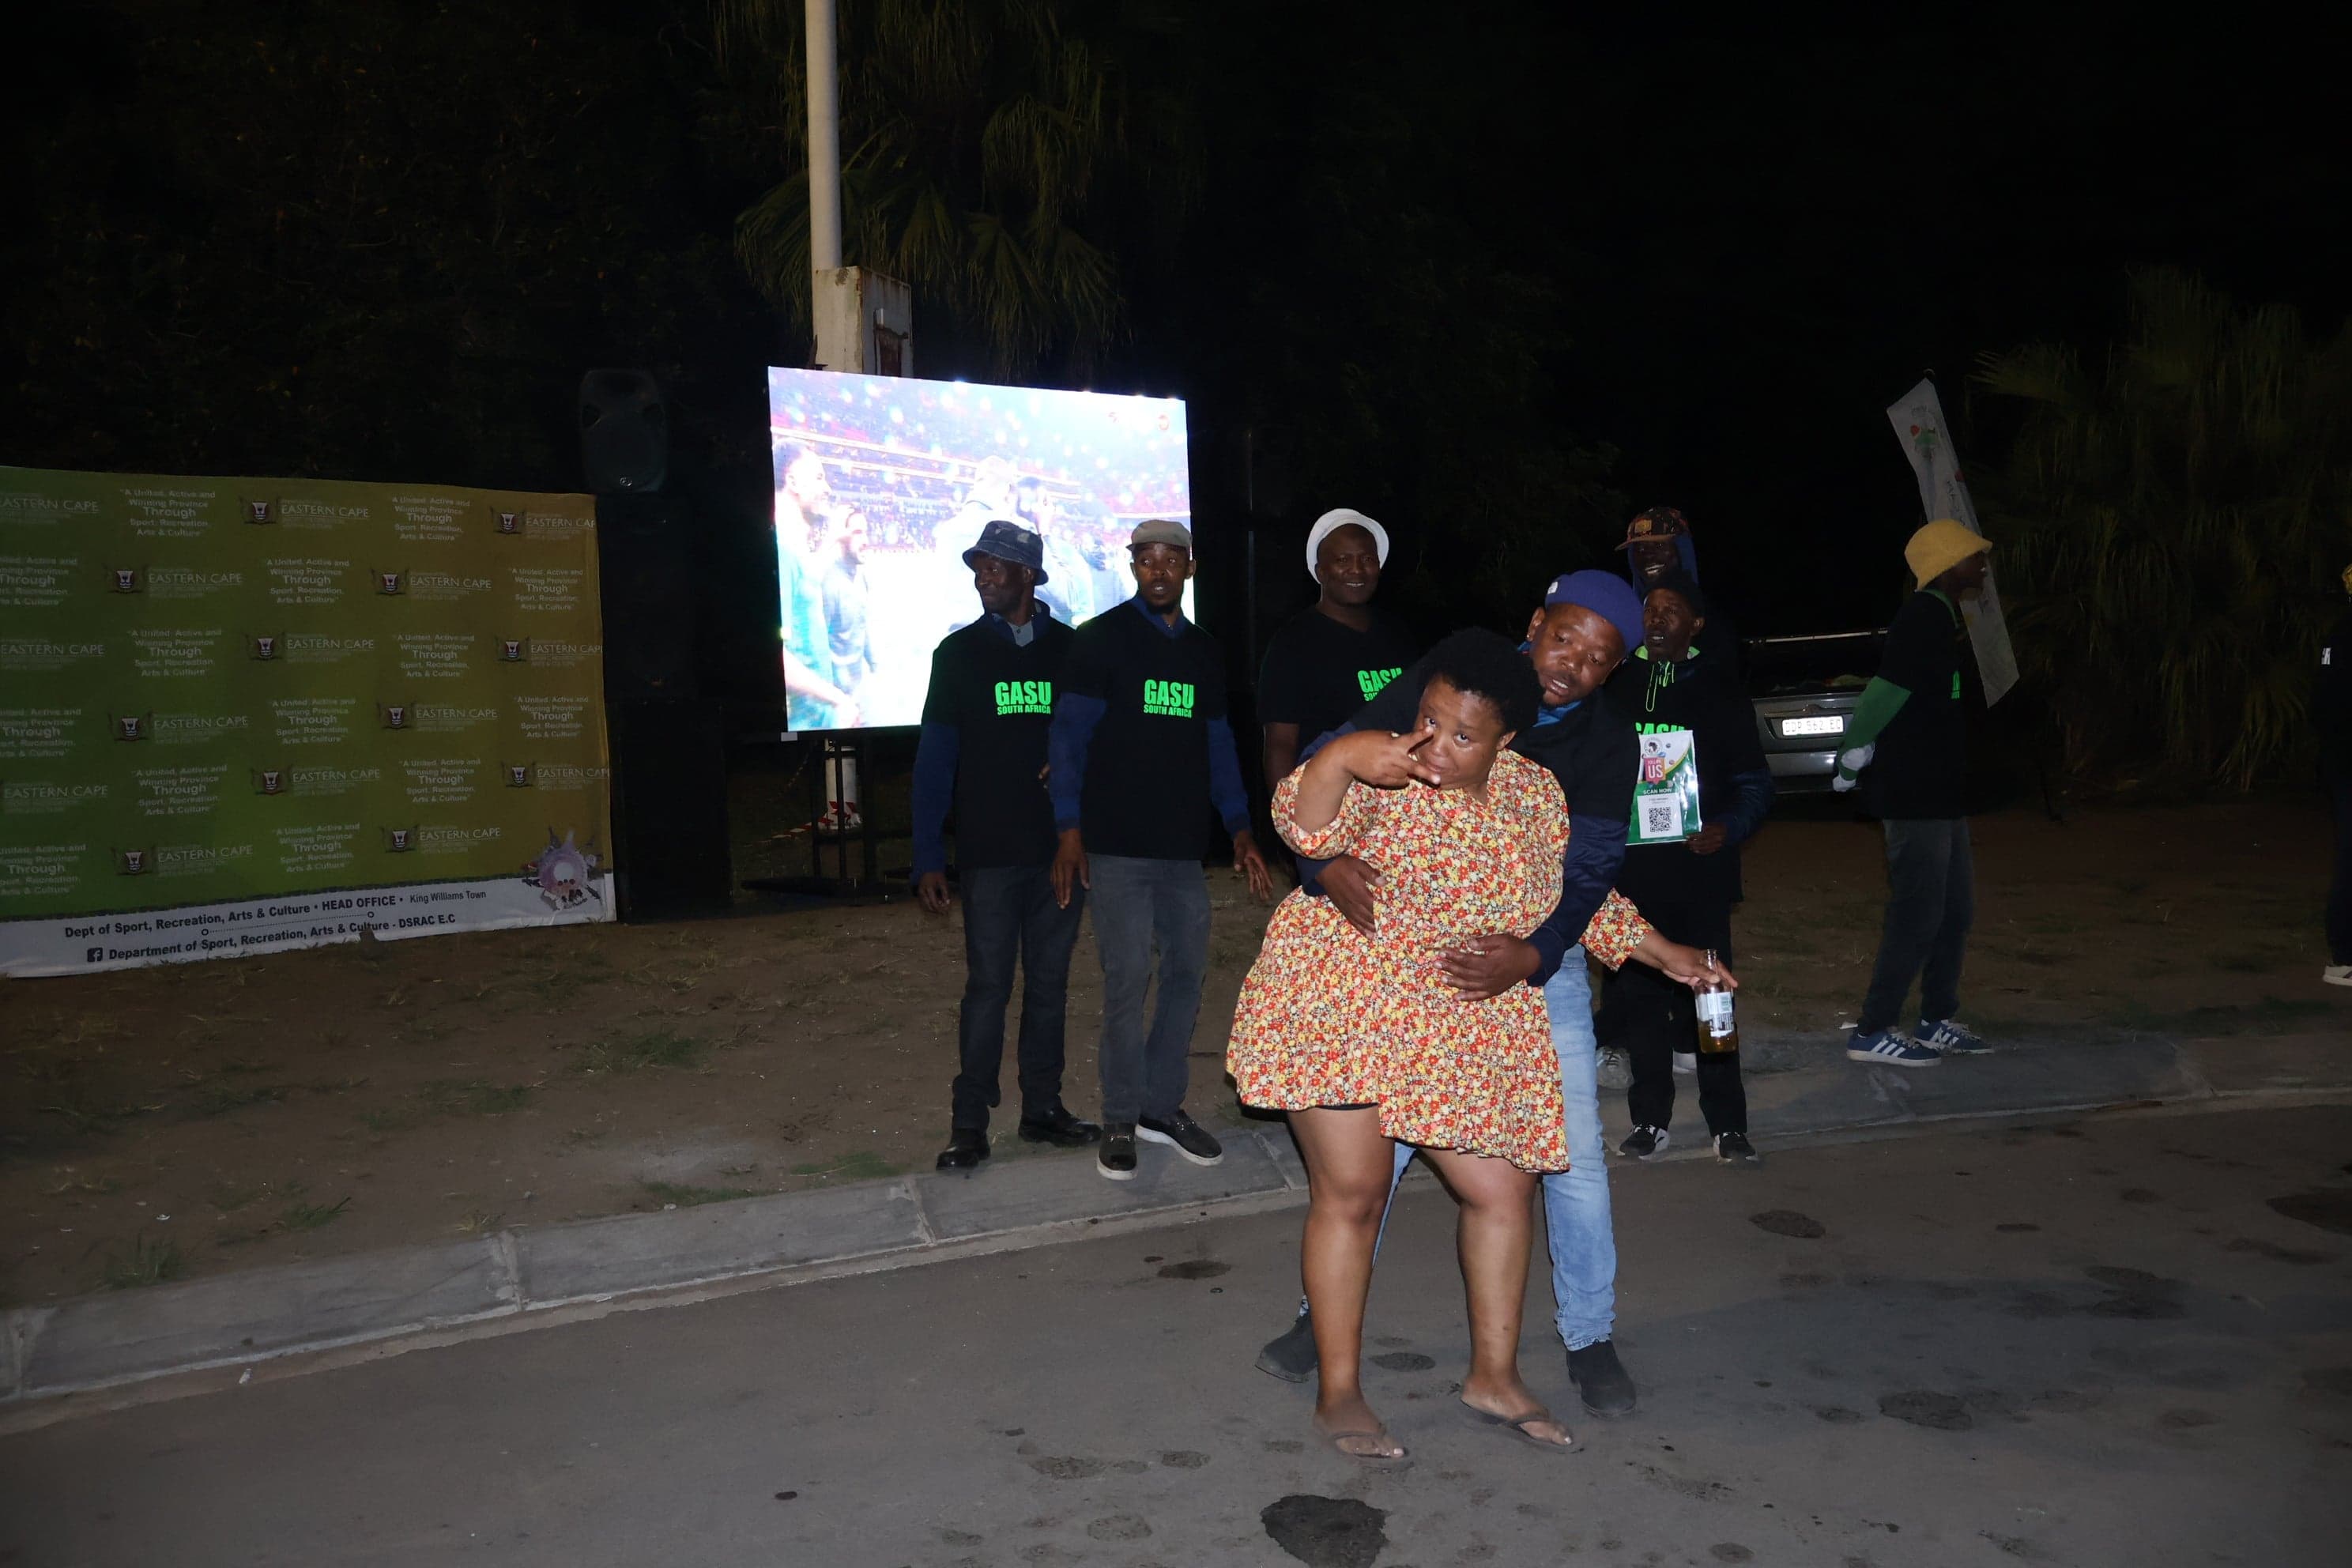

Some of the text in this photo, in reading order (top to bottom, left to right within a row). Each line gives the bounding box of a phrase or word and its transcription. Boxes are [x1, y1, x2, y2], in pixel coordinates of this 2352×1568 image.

[0, 498, 100, 512] ASTERN CAPE
[143, 507, 196, 518] Through
[281, 504, 371, 518] EASTERN CAPE
[406, 513, 452, 524] Through
[526, 518, 595, 528] EASTERN CAP
[0, 574, 55, 587] Through
[149, 573, 242, 583] EASTERN CAPE
[283, 575, 330, 586] Through
[410, 576, 492, 589] EASTERN CAPE
[526, 584, 567, 594] Through
[1, 644, 104, 654] EASTERN CAPE
[287, 639, 374, 649] EASTERN CAPE
[530, 644, 602, 654] EASTERN CAP
[149, 647, 202, 658] Through
[413, 650, 457, 660] Through
[994, 680, 1052, 706] GASU
[1144, 678, 1195, 708] GASU
[416, 708, 498, 718] EASTERN CAPE
[997, 704, 1052, 716] SOUTH AFRICA
[1144, 703, 1193, 718] SOUTH AFRICA
[154, 715, 247, 729] EASTERN CAPE
[288, 714, 337, 726] Through
[532, 711, 574, 722] Through
[3, 727, 60, 738] Through
[292, 768, 380, 782] EASTERN CAPE
[537, 767, 609, 778] EASTERN CAP
[1649, 764, 1663, 778] US
[418, 775, 464, 786] Through
[4, 785, 108, 798] EASTERN CAPE
[153, 784, 206, 795] Through
[420, 827, 501, 841] EASTERN CAPE
[292, 841, 341, 852] Through
[158, 844, 253, 863] EASTERN CAPE
[8, 863, 65, 875] Through
[65, 891, 486, 938] Dept of Sport, Recreation, Arts & Culture HEAD OFFICE King Williams Town
[109, 944, 182, 959] Department
[186, 940, 197, 952] of
[202, 937, 237, 950] Sport,
[241, 929, 307, 945] Recreation,
[310, 925, 334, 937] Arts
[337, 923, 345, 933] &
[349, 922, 390, 932] Culture
[398, 915, 435, 928] DSRAC
[439, 914, 456, 924] E.C
